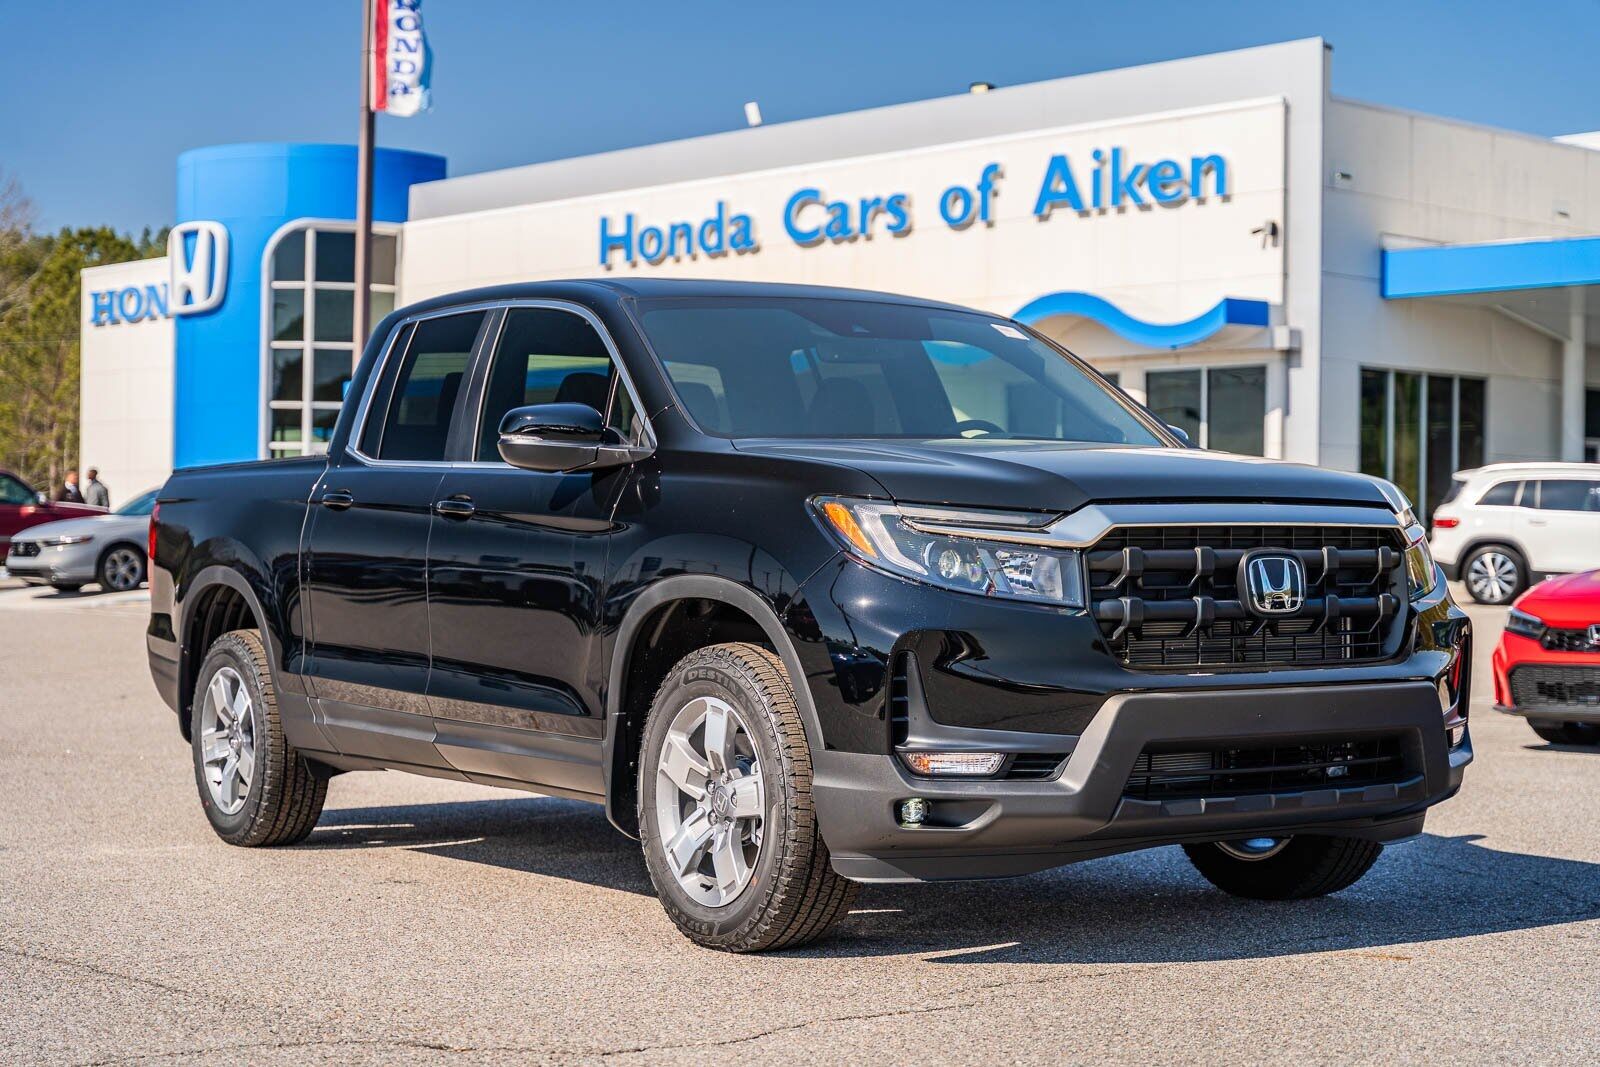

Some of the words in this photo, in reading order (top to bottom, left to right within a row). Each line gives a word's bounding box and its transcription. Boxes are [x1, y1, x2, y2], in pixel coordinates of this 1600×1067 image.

[600, 201, 756, 266] Honda
[784, 187, 910, 246] Cars
[939, 162, 1001, 227] of
[1033, 146, 1228, 218] Aiken
[90, 283, 168, 323] HON
